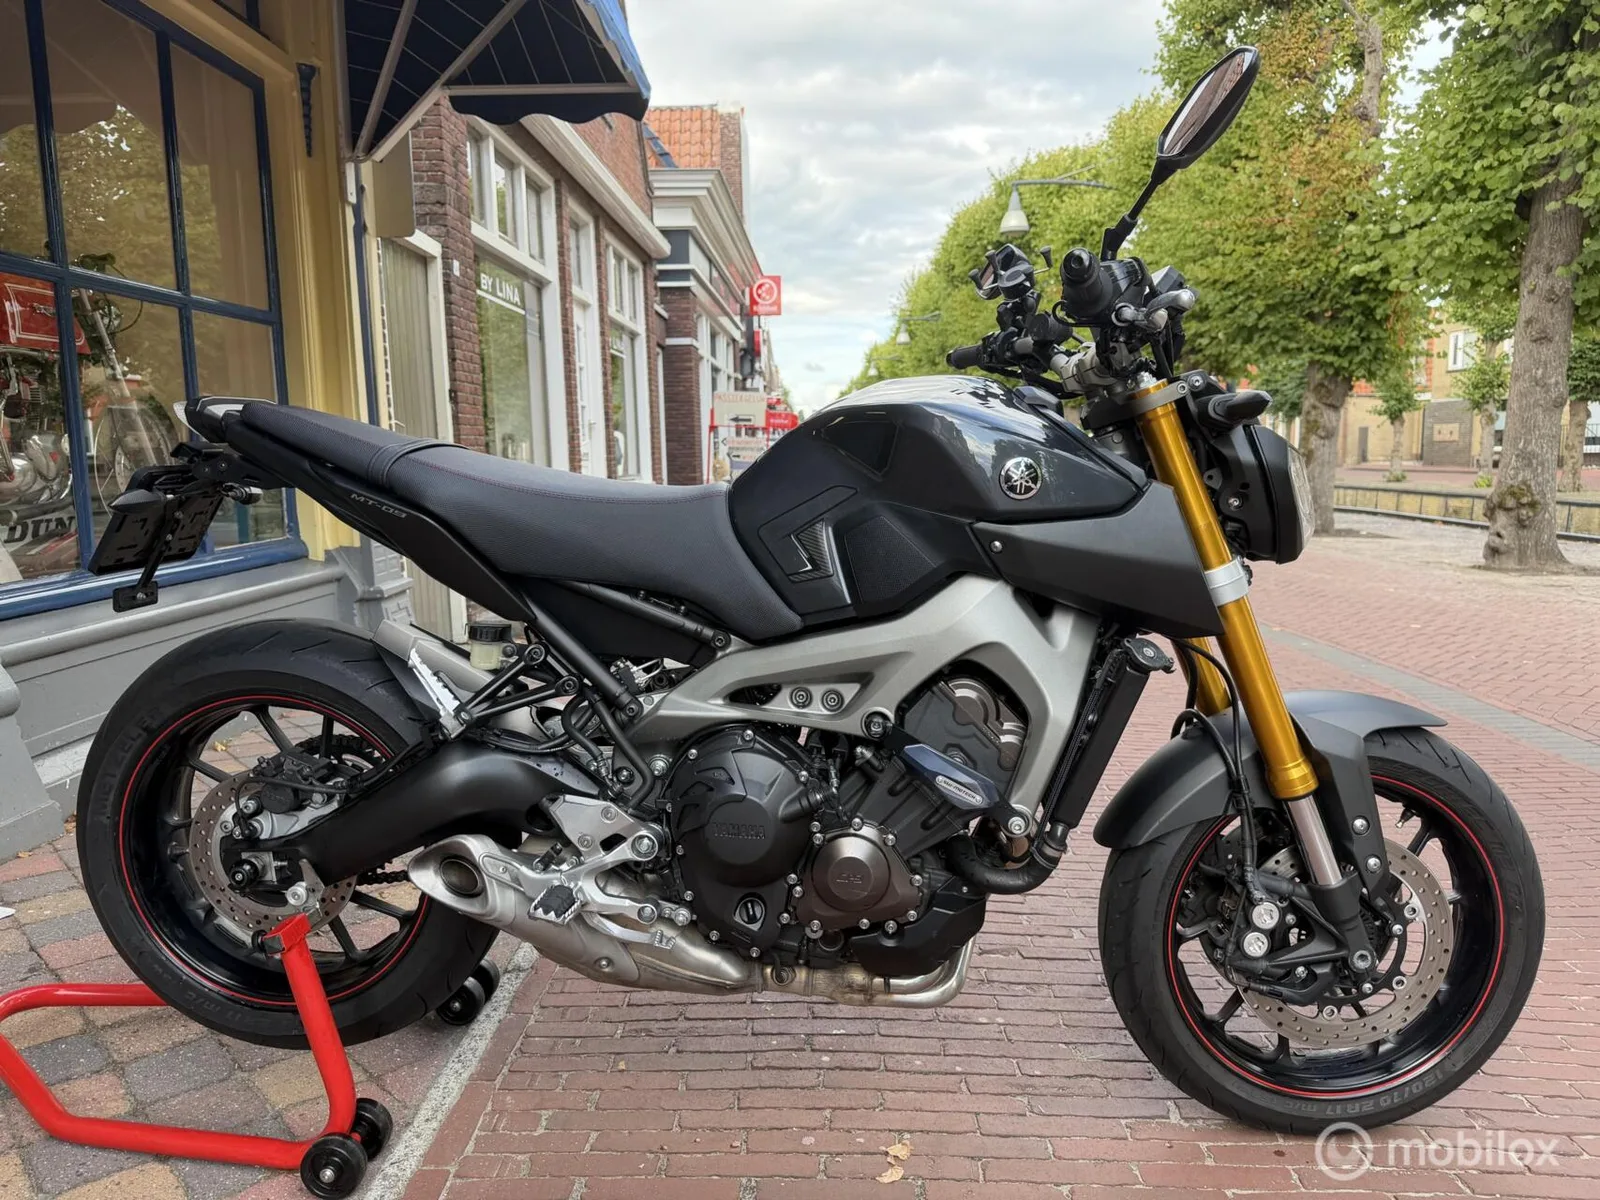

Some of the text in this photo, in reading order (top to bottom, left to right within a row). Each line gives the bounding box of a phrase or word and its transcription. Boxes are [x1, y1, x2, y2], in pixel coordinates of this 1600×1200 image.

[480, 272, 521, 306] BY LINA
[350, 493, 408, 519] MT-09
[712, 821, 766, 840] YAMAHA
